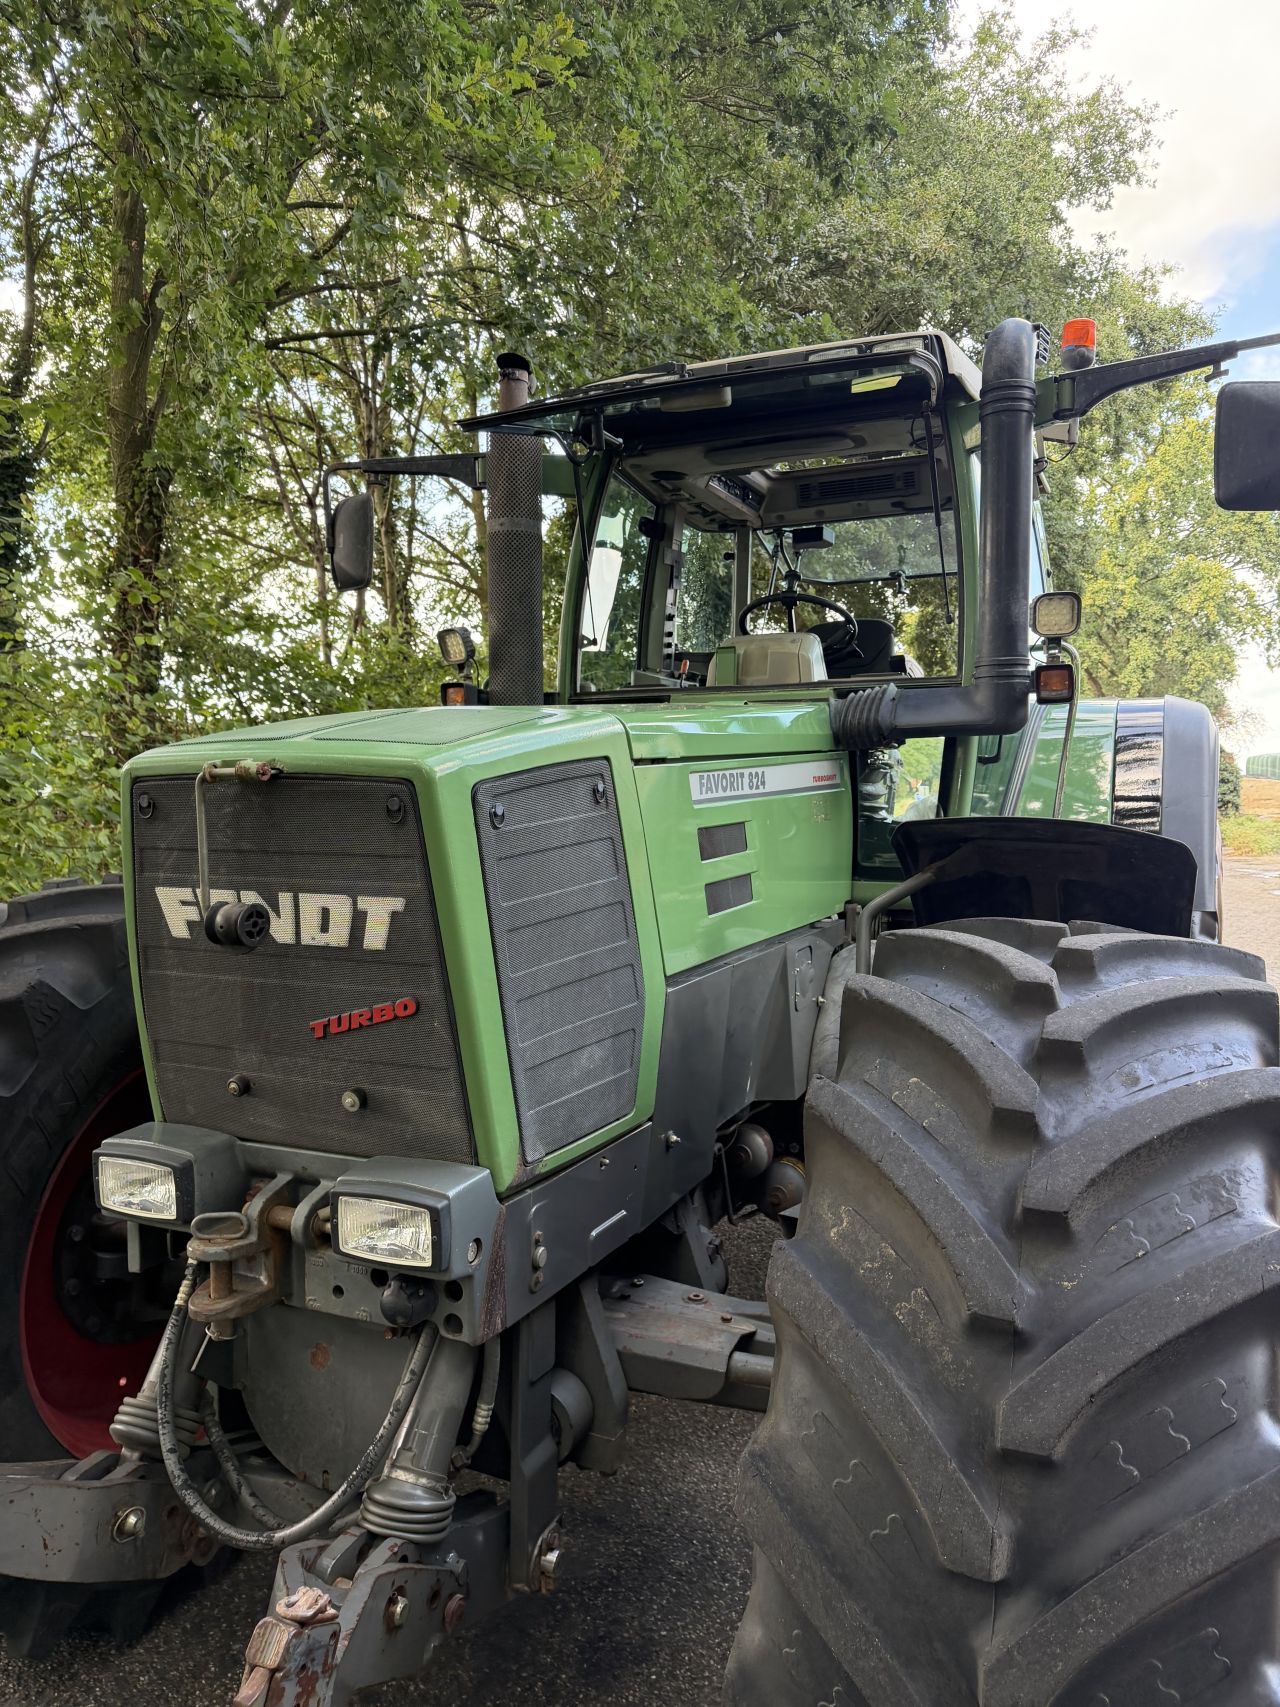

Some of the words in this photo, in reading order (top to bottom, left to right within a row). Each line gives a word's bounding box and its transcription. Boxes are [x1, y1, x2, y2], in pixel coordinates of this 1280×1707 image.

[699, 772, 745, 795] FAVORIT
[748, 771, 766, 790] 824
[309, 996, 418, 1039] TURBO
